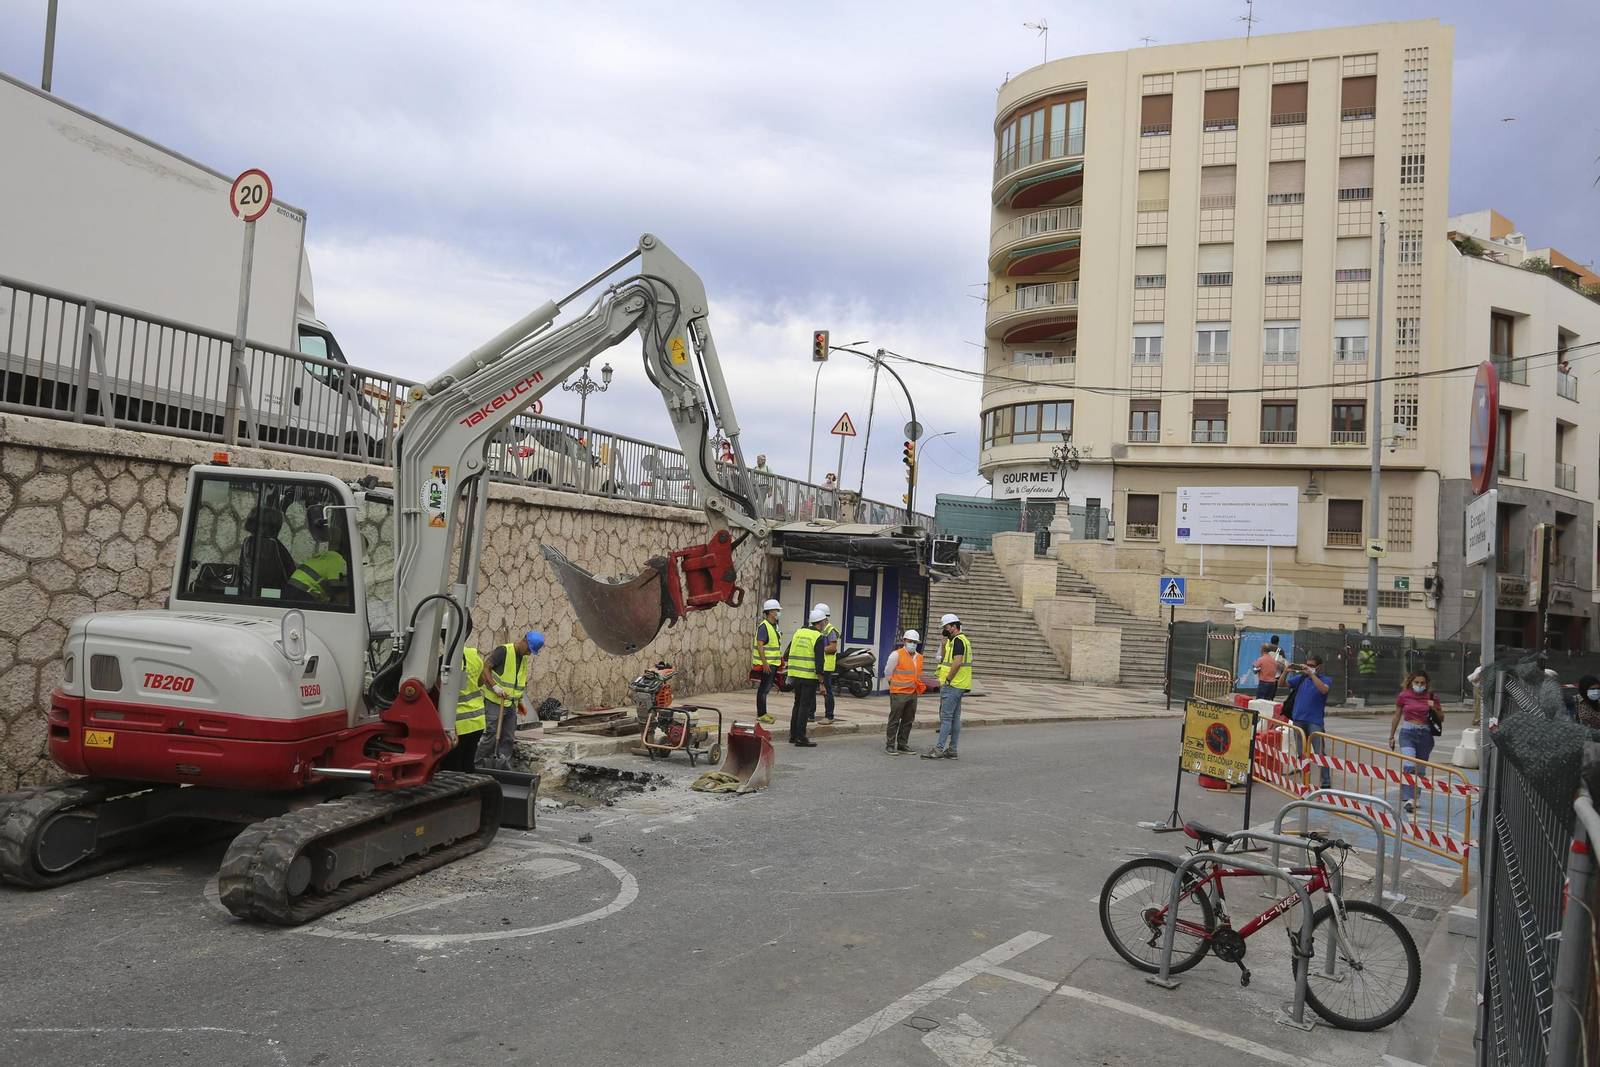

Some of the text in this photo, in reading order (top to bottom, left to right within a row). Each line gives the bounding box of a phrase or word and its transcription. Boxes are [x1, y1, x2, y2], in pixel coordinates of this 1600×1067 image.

[240, 184, 263, 205] 20
[460, 370, 544, 428] TAKEUCHI
[1002, 471, 1058, 484] GOURMET
[1470, 510, 1486, 529] Excepto
[1469, 530, 1486, 551] patinetes
[143, 673, 195, 692] TB260
[300, 684, 321, 698] TB260
[1197, 710, 1219, 720] MALAGA
